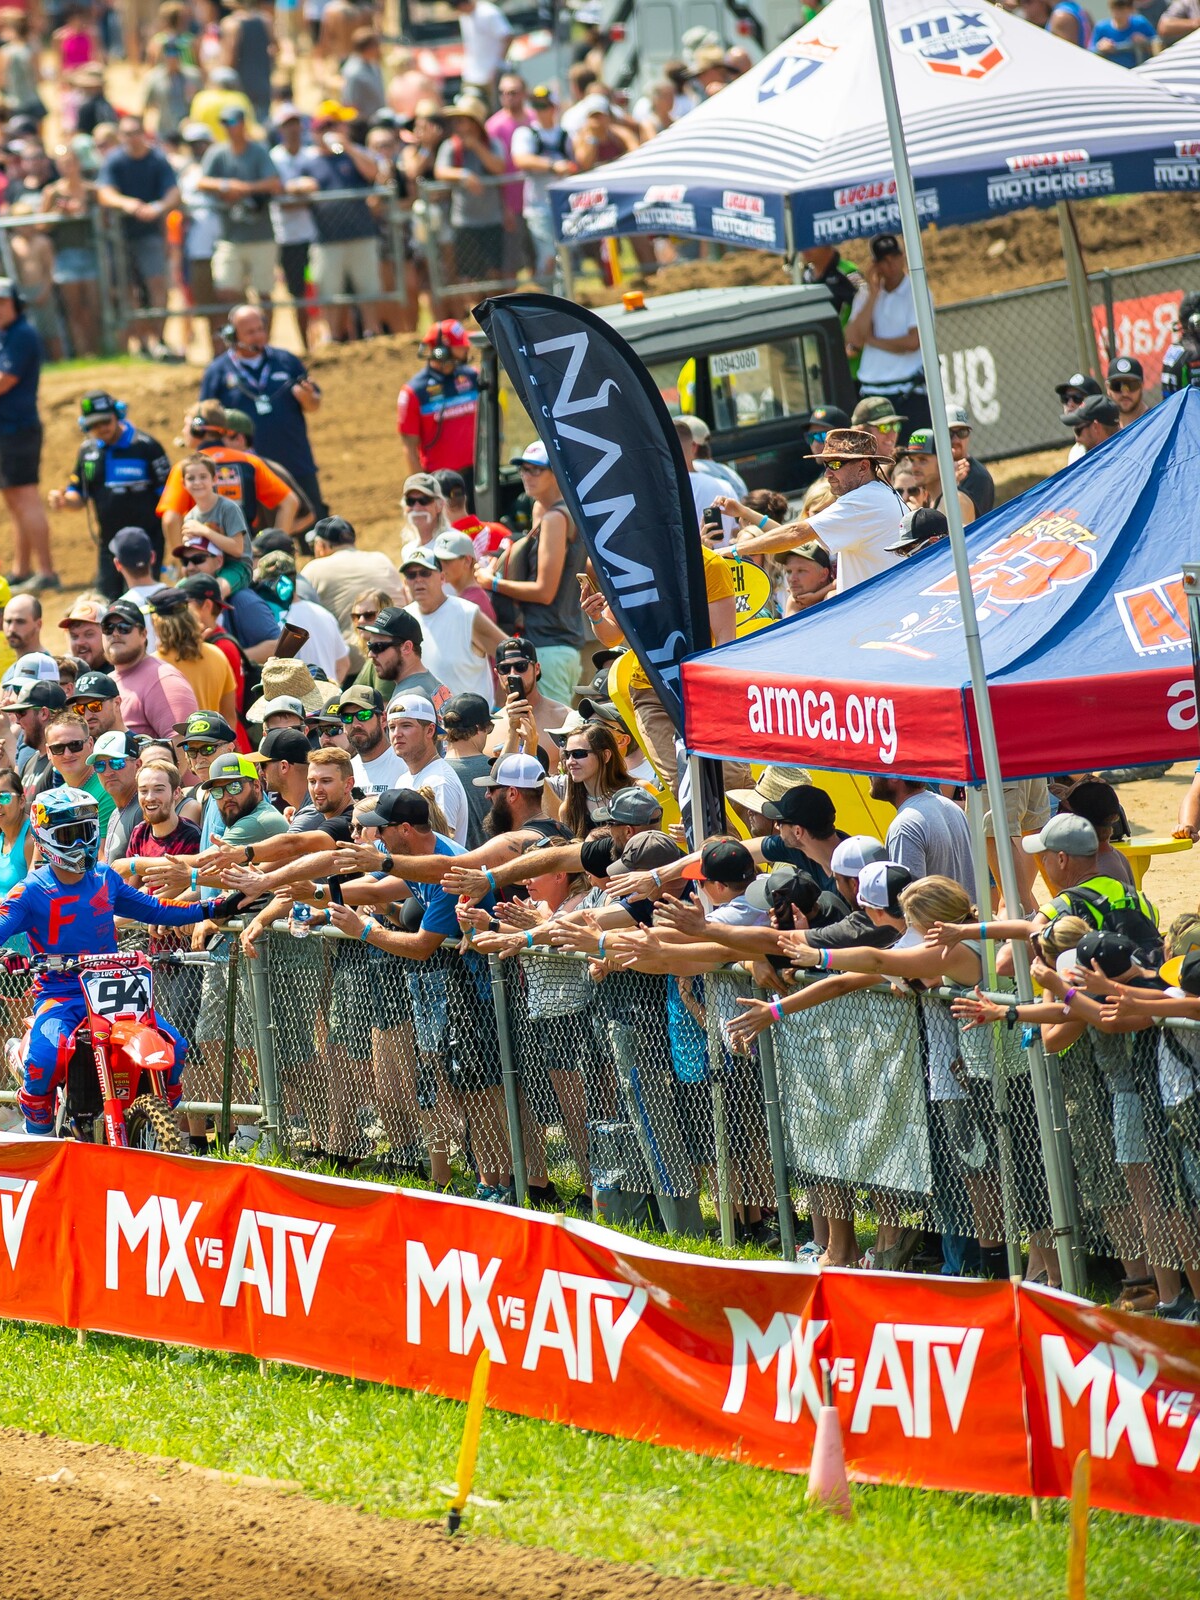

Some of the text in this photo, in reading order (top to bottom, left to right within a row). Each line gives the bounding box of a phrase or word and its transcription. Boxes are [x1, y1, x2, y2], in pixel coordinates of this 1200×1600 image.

[837, 182, 884, 206] LUCAS
[987, 170, 1114, 201] MOTOCROSS
[813, 194, 940, 237] MOTOCRSS
[713, 350, 758, 373] 10943080
[748, 684, 898, 765] armca.org
[83, 952, 138, 961] RENTHAL
[98, 978, 145, 1015] 94
[105, 1189, 337, 1318] MX VS ATV
[406, 1239, 649, 1384] MX VS ATV
[721, 1307, 985, 1439] MX VS ATV
[1041, 1333, 1160, 1468] MX
[1156, 1389, 1196, 1430] VS
